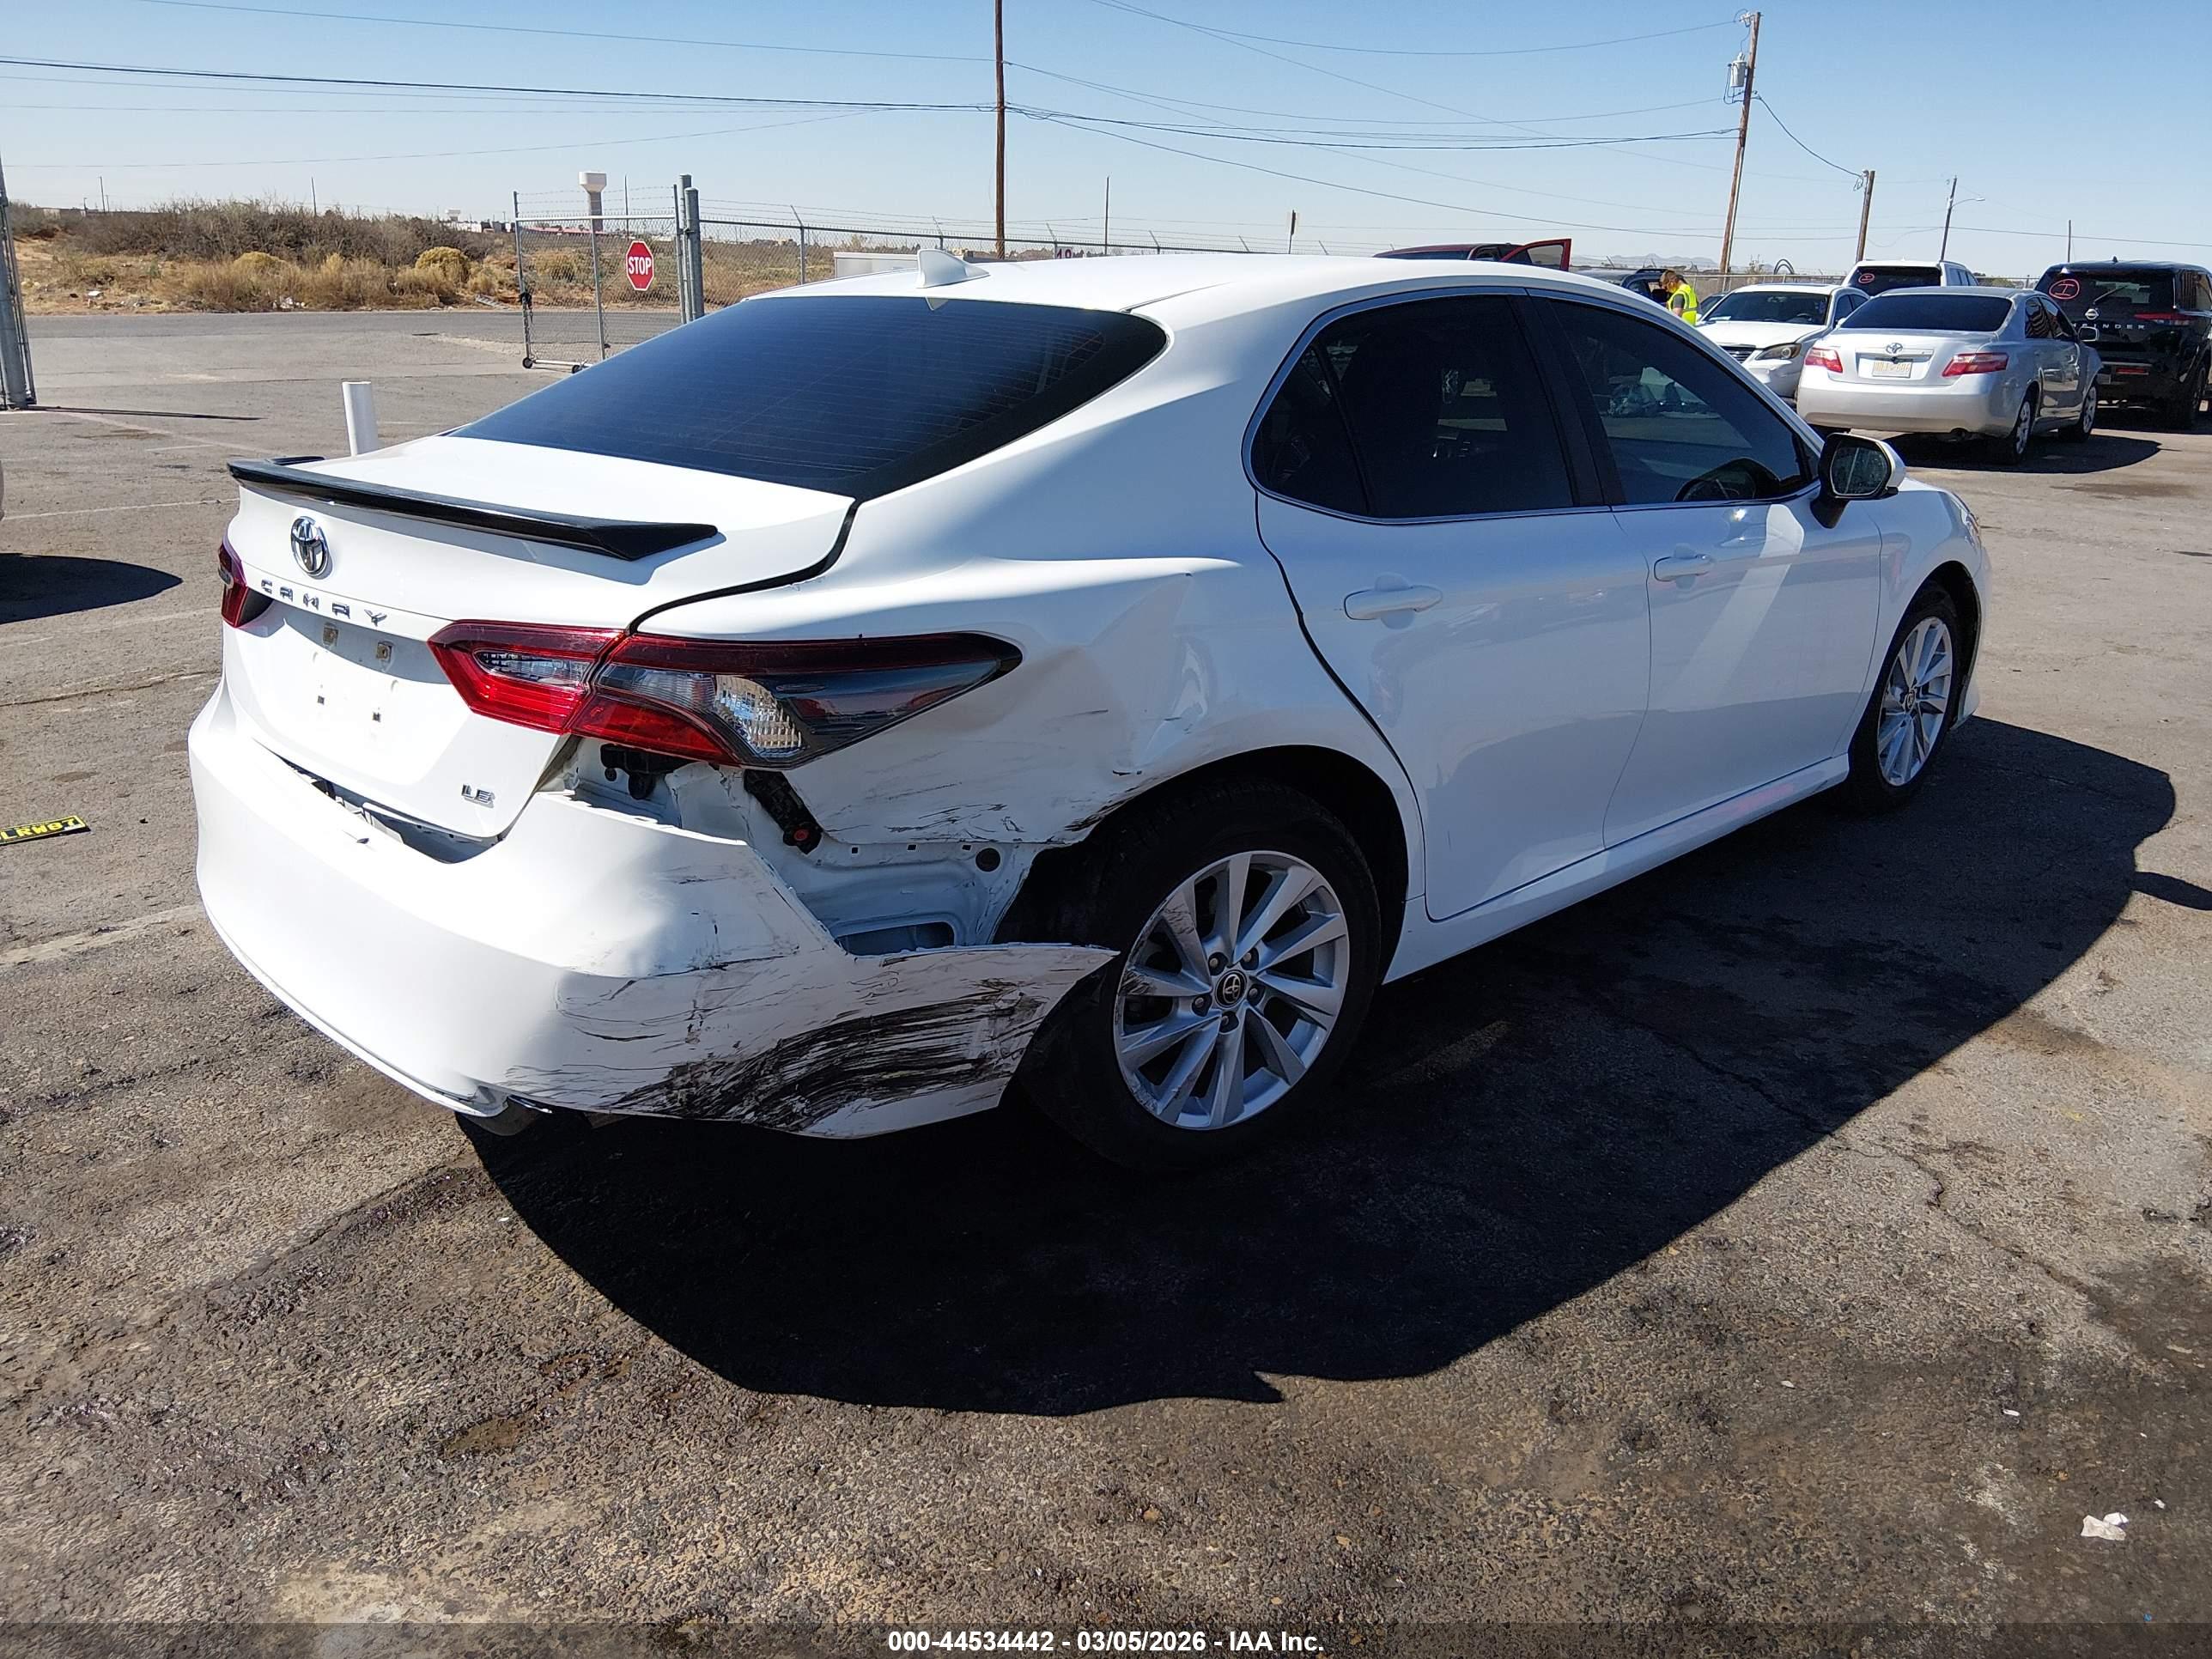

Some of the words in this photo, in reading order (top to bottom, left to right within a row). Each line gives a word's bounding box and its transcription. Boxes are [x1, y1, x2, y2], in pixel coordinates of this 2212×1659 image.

[629, 256, 652, 275] STOP
[261, 579, 387, 627] CAMRY
[461, 784, 495, 804] LE
[0, 818, 75, 840] LRW87
